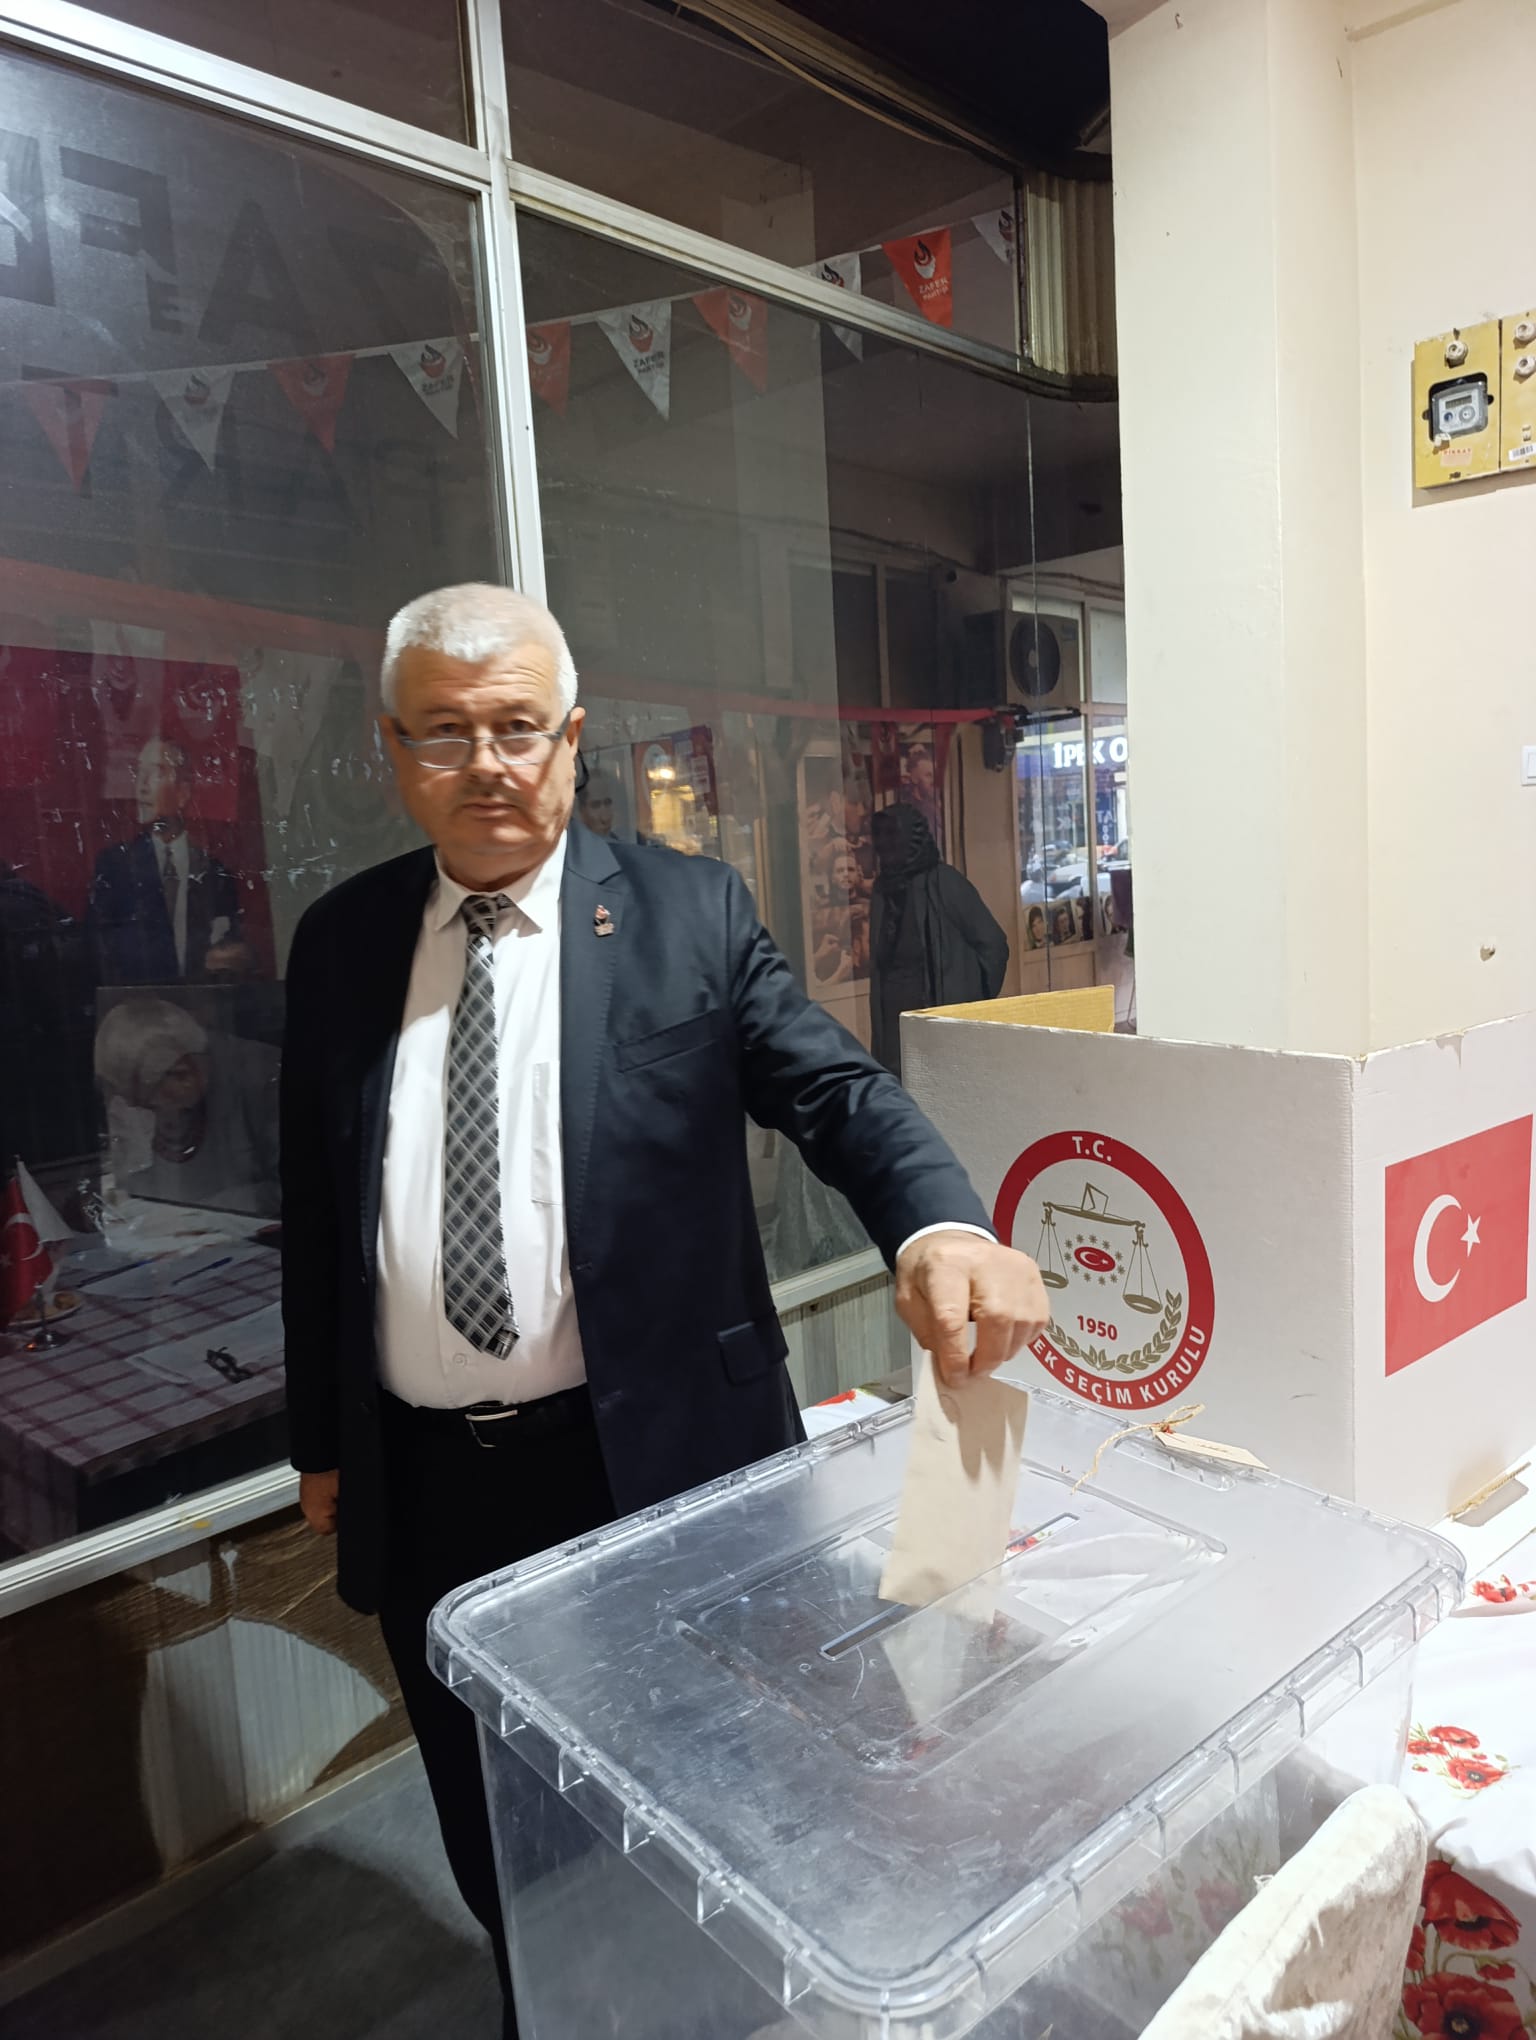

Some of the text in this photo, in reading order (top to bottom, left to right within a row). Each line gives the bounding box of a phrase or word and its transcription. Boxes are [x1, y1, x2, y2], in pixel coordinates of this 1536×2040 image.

[1071, 1135, 1113, 1162] T.C.
[1076, 1314, 1118, 1341] 1950
[1064, 1367, 1133, 1405] SEÇİM
[1139, 1325, 1206, 1403] KURULU
